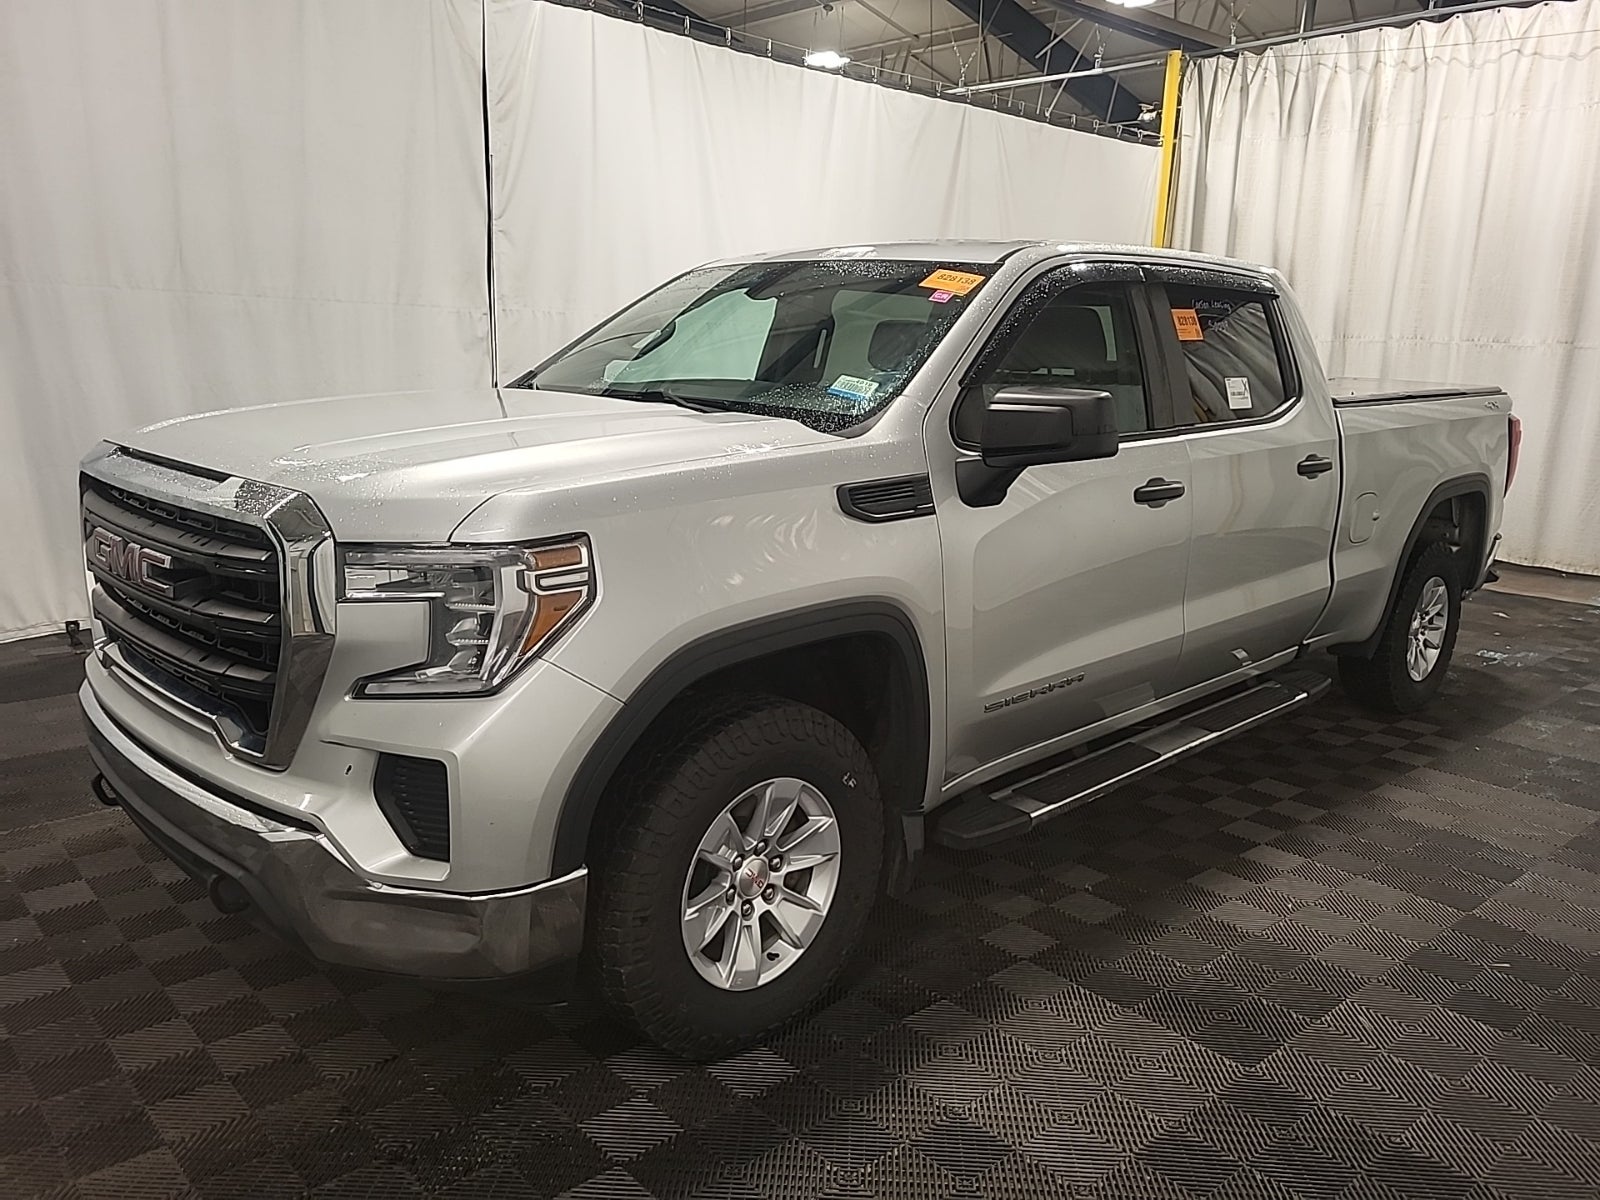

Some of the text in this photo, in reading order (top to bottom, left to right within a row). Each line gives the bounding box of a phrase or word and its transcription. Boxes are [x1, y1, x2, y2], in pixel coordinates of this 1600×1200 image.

[90, 527, 173, 598] GMC
[984, 672, 1085, 713] SIERRA
[745, 868, 765, 889] GMC
